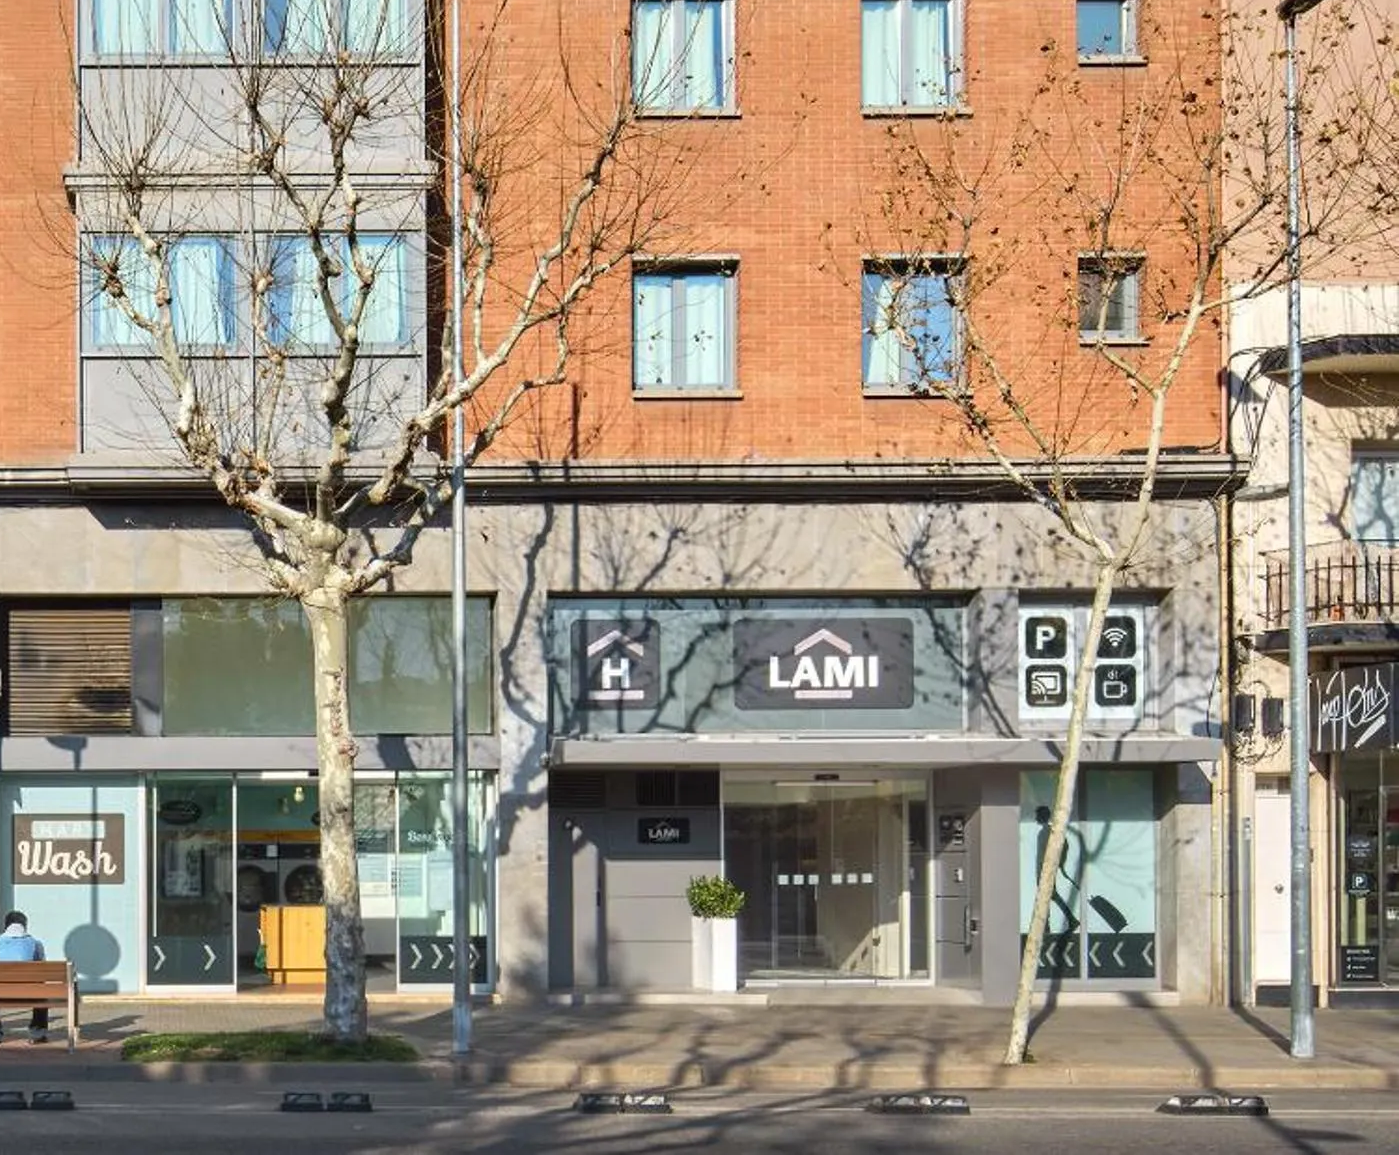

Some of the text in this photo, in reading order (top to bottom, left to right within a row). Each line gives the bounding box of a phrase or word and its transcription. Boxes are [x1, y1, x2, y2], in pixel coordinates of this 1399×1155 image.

[1036, 626, 1056, 650] P
[601, 657, 631, 689] H
[769, 656, 879, 688] LAMI
[18, 841, 117, 879] Wash
